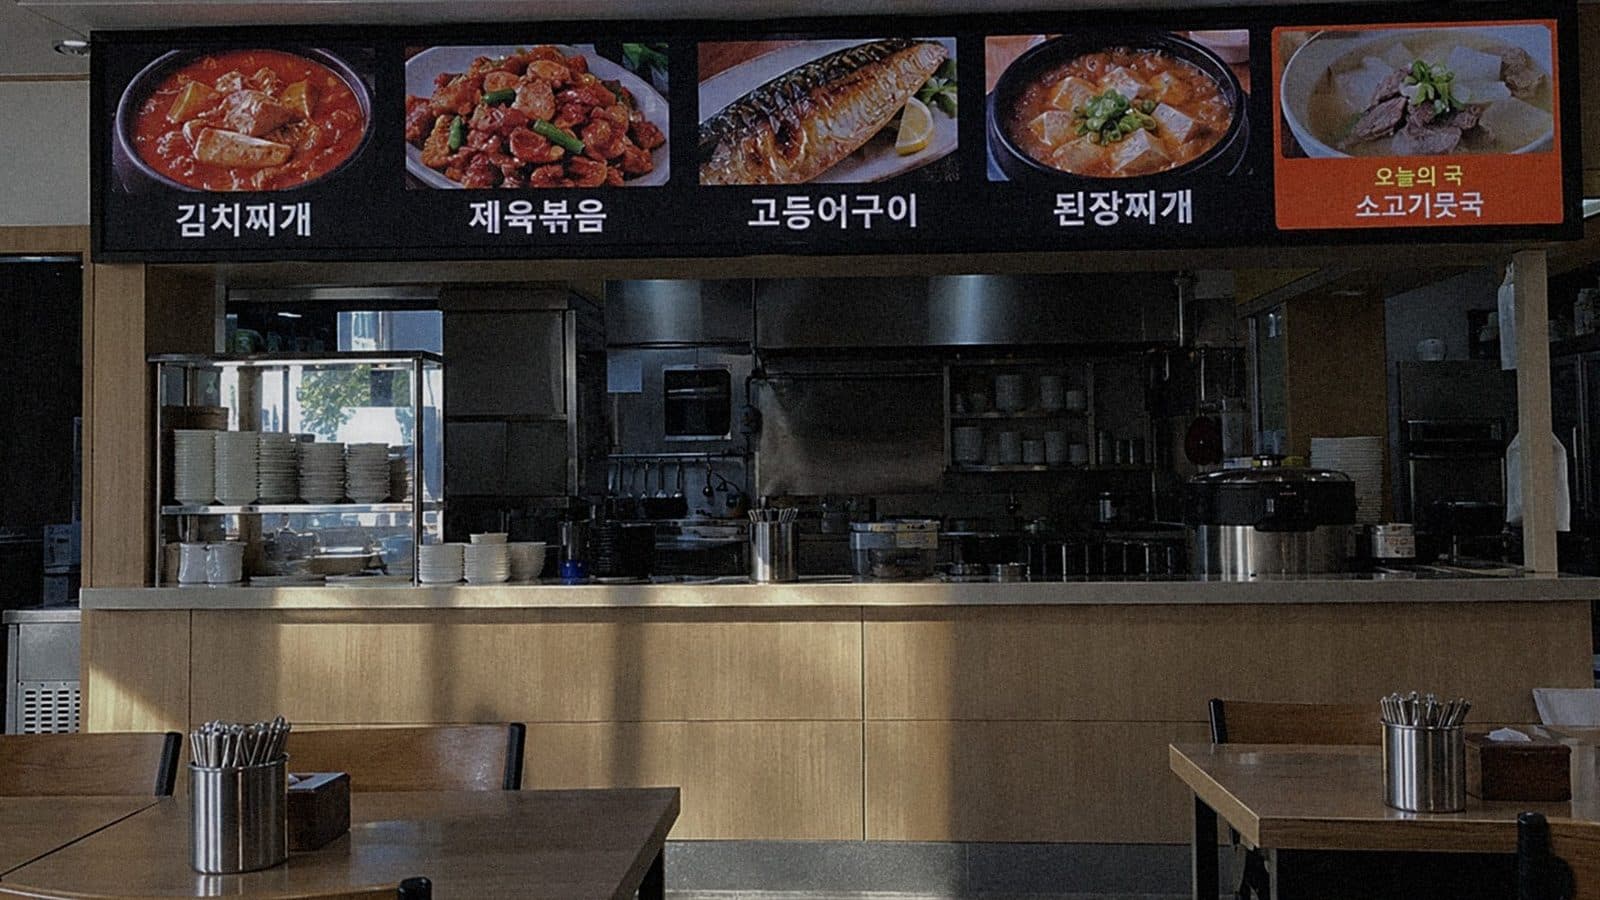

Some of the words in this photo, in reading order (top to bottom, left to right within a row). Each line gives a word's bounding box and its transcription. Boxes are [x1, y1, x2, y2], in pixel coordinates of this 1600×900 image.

[1375, 166, 1436, 187] 오늘의
[1444, 165, 1463, 186] 국
[175, 202, 311, 238] 김치찌개
[468, 199, 607, 235] 제육볶음
[747, 193, 917, 230] 고등어구이
[1053, 189, 1193, 227] 된장찌개
[1356, 192, 1484, 218] 소고기뭇국
